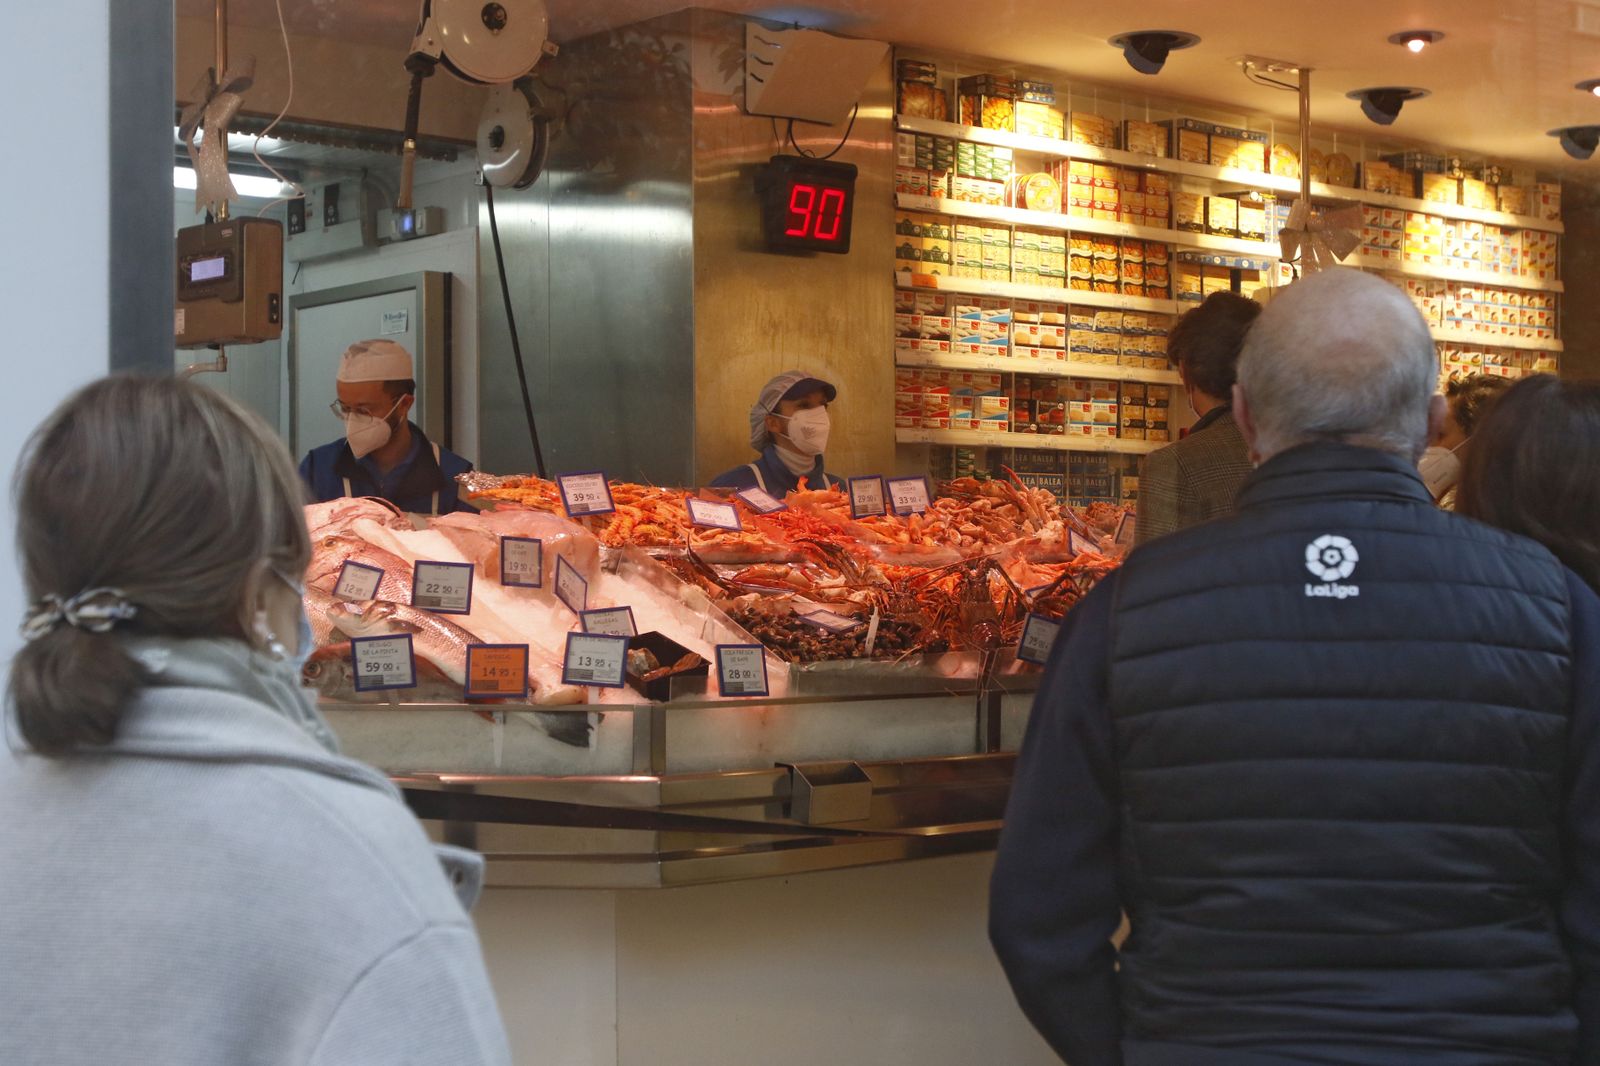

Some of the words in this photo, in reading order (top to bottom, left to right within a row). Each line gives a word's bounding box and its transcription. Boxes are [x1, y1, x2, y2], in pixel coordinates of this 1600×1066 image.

[785, 184, 845, 239] 90
[1039, 477, 1061, 486] BALEA
[573, 493, 584, 502] 39
[509, 561, 519, 571] 19
[343, 583, 355, 594] 12
[425, 583, 440, 593] 22
[442, 585, 453, 594] 50
[1305, 582, 1359, 600] LaLiga
[578, 656, 592, 667] 13
[594, 658, 606, 667] 95
[366, 662, 380, 673] 59
[382, 662, 393, 672] 00
[483, 666, 496, 677] 14
[728, 669, 741, 679] 28
[742, 670, 751, 679] 00
